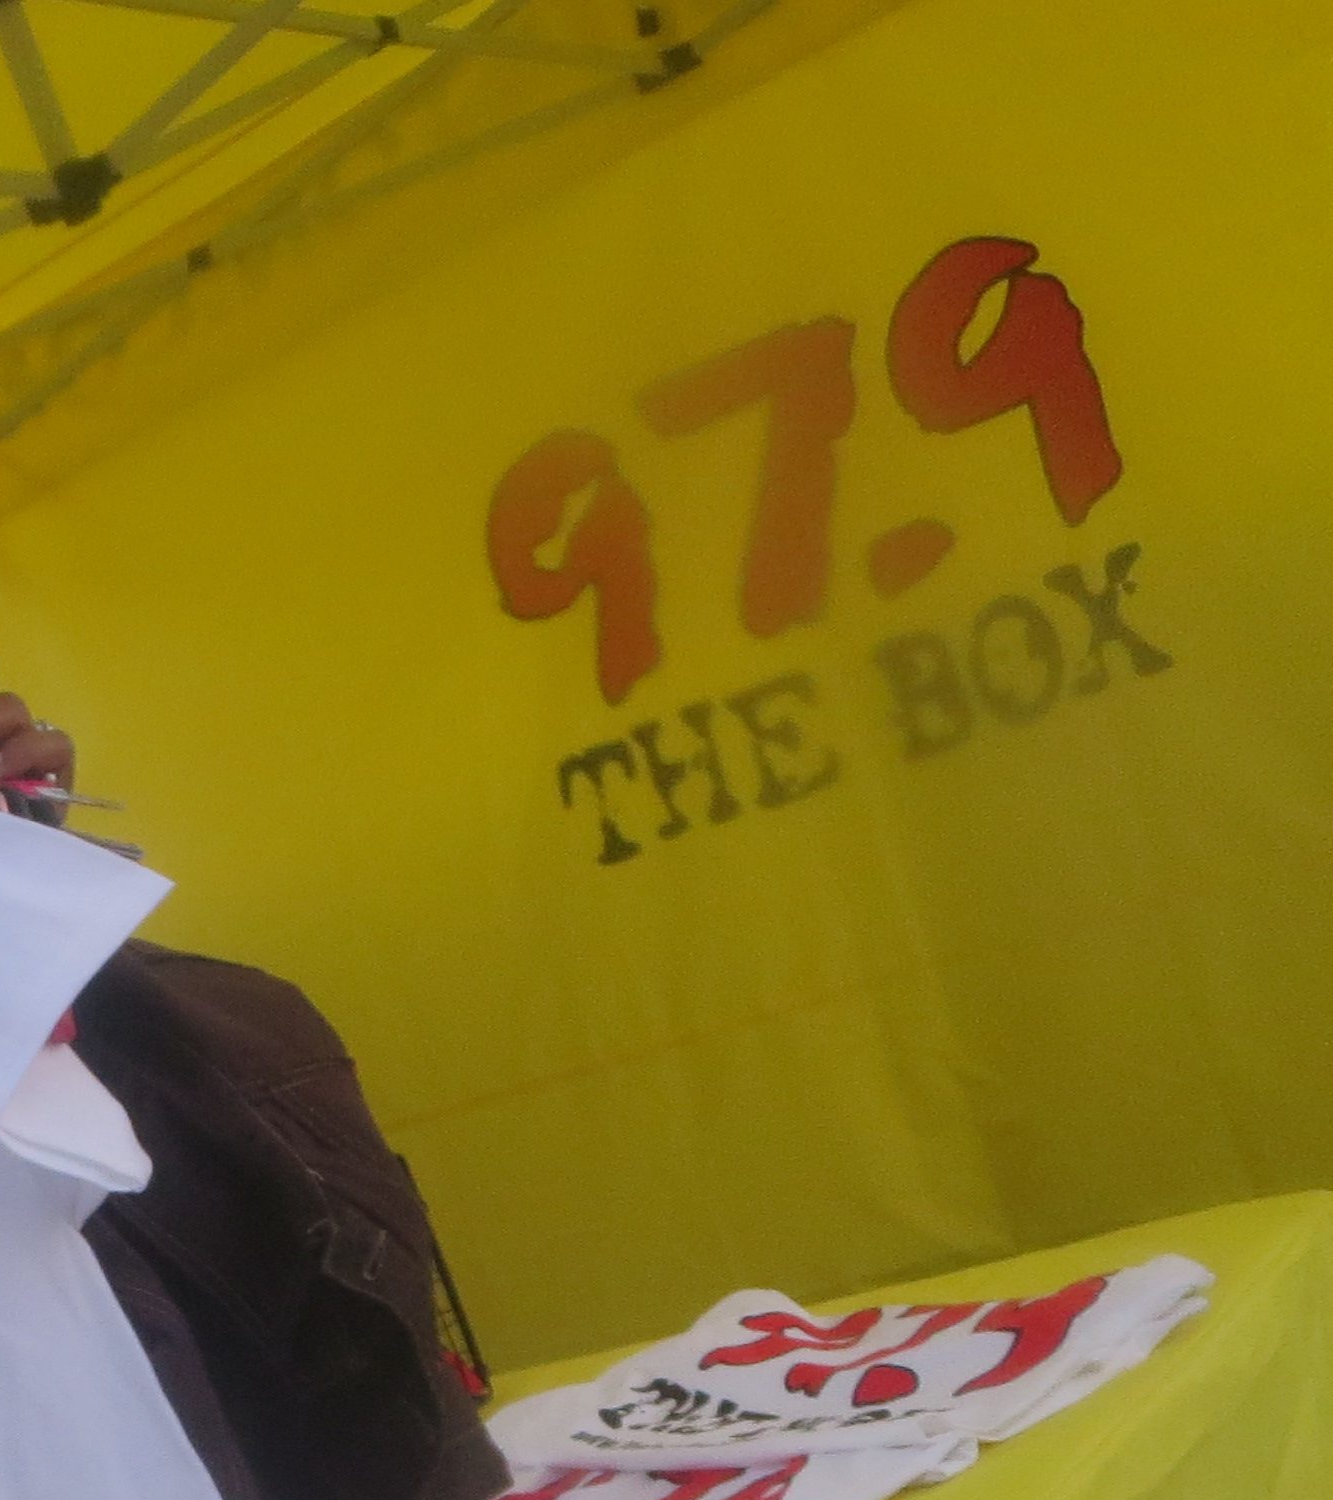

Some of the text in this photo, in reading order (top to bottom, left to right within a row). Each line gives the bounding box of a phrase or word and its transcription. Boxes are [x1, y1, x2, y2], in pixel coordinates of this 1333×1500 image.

[485, 235, 1123, 706] 97.9
[556, 541, 1174, 866] THE BOX
